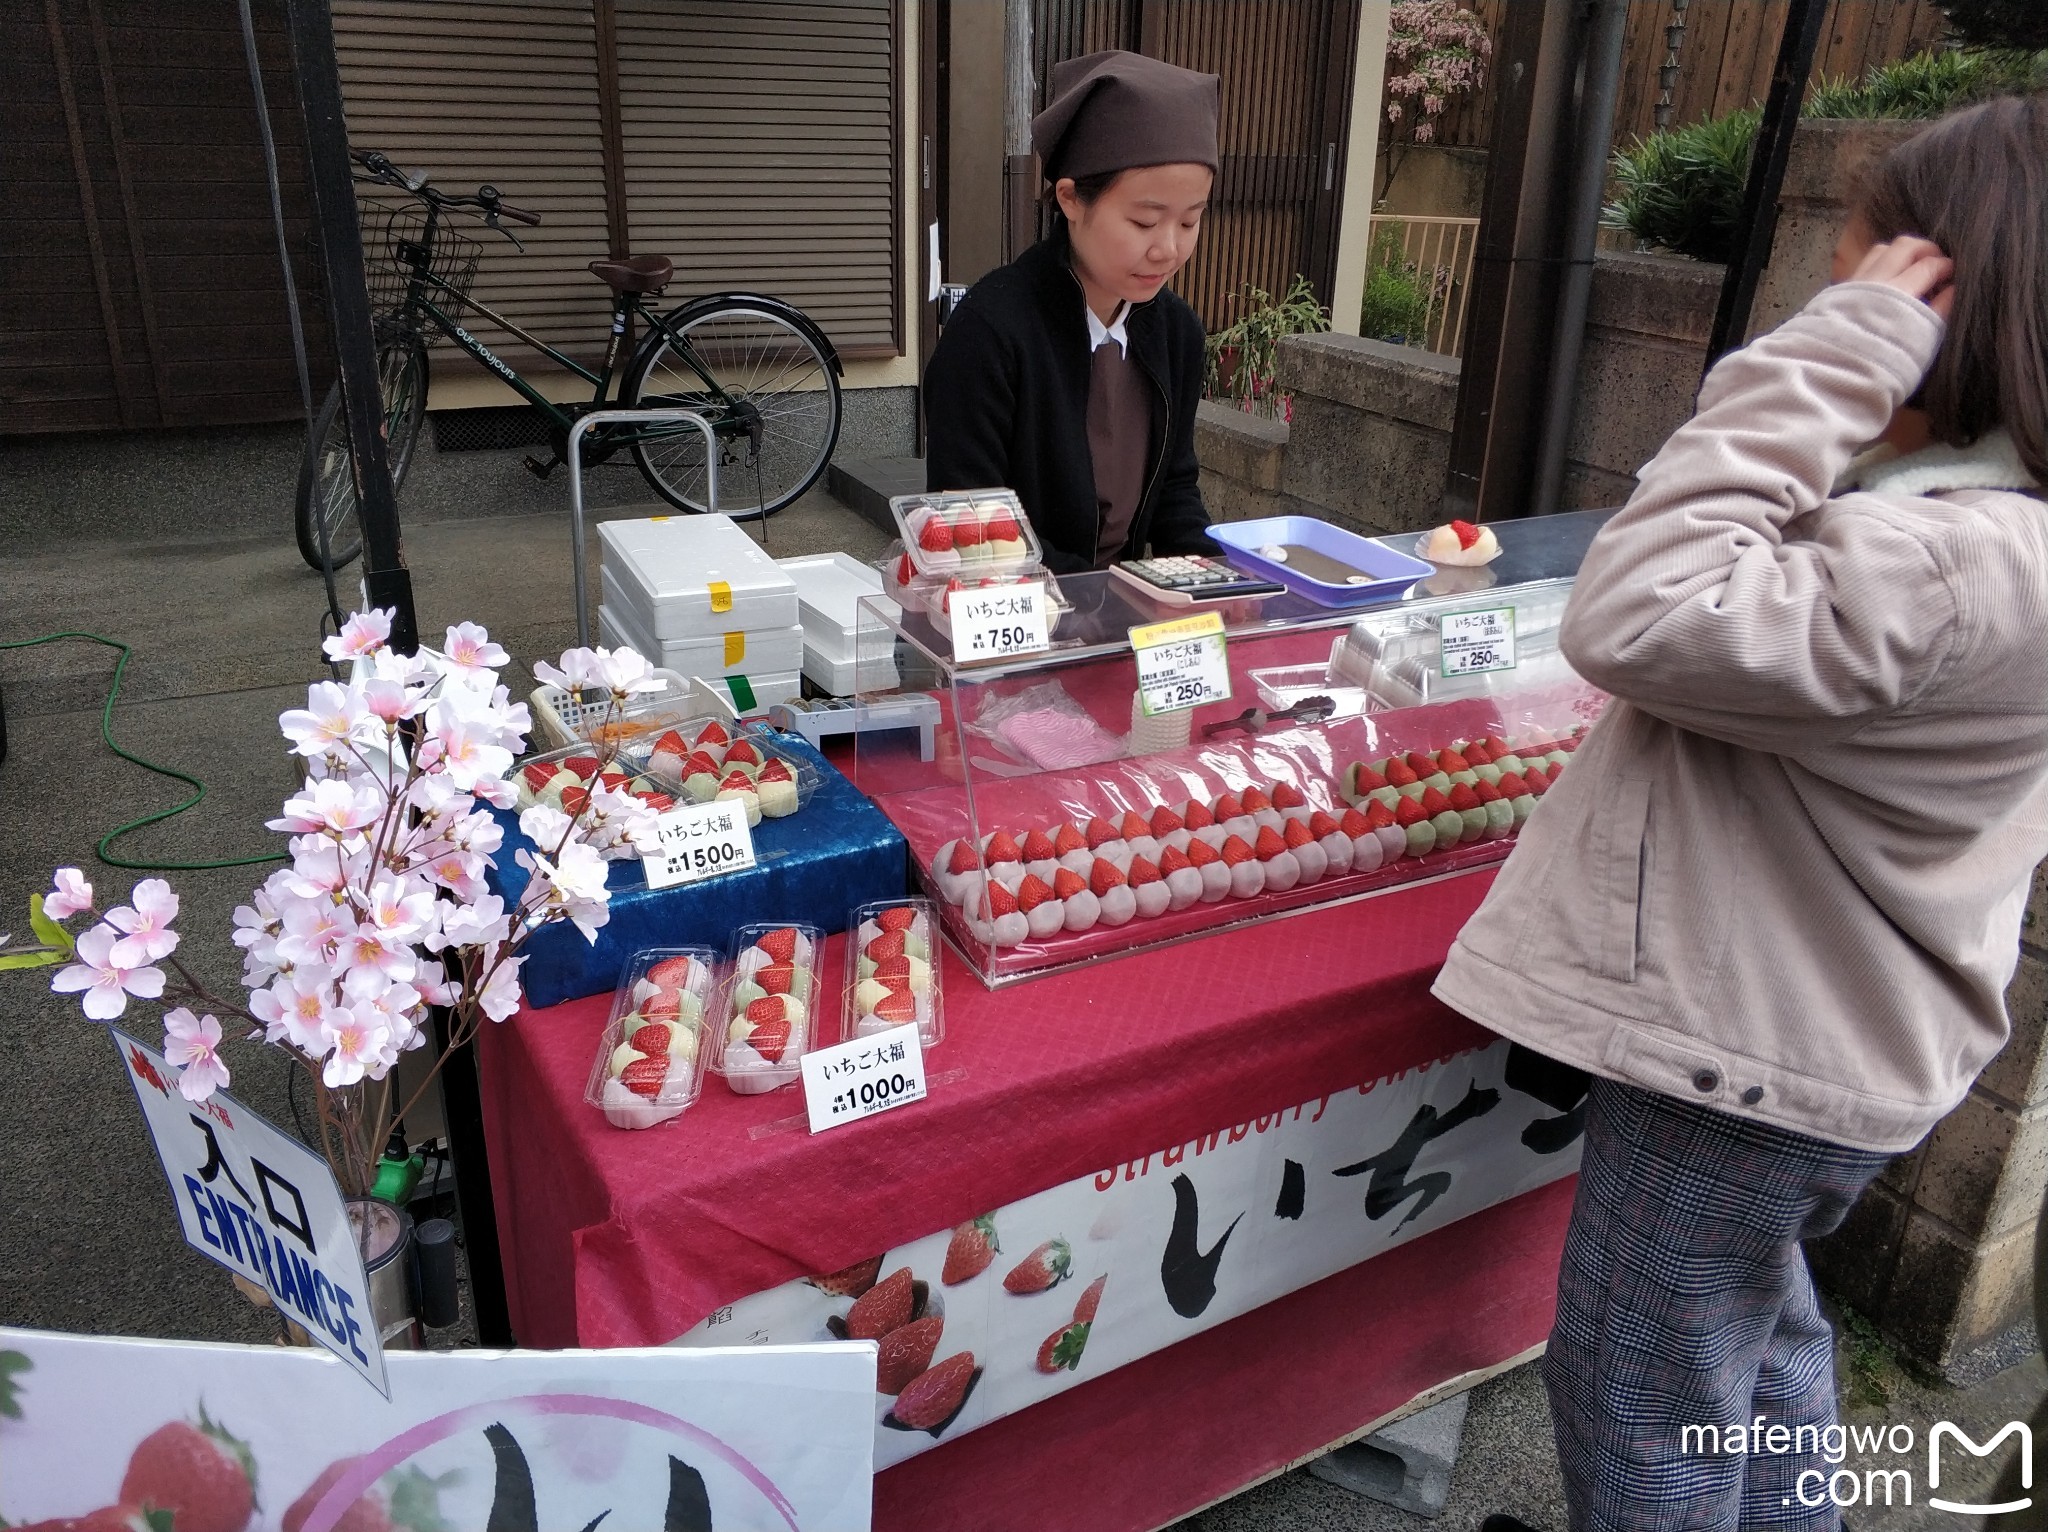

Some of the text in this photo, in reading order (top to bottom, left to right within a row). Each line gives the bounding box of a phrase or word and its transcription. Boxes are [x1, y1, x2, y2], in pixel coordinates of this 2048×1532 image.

[966, 596, 1033, 619] いちご大福
[1455, 614, 1495, 628] いちご大福
[988, 626, 1034, 648] 750円
[1154, 642, 1202, 662] いちご大福
[658, 814, 733, 844] いちご大福
[680, 842, 745, 871] 1500円
[822, 1040, 905, 1081] いちご大福
[846, 1073, 916, 1109] 1000円
[189, 1112, 317, 1256] 入口
[183, 1172, 369, 1368] ENTRANCE
